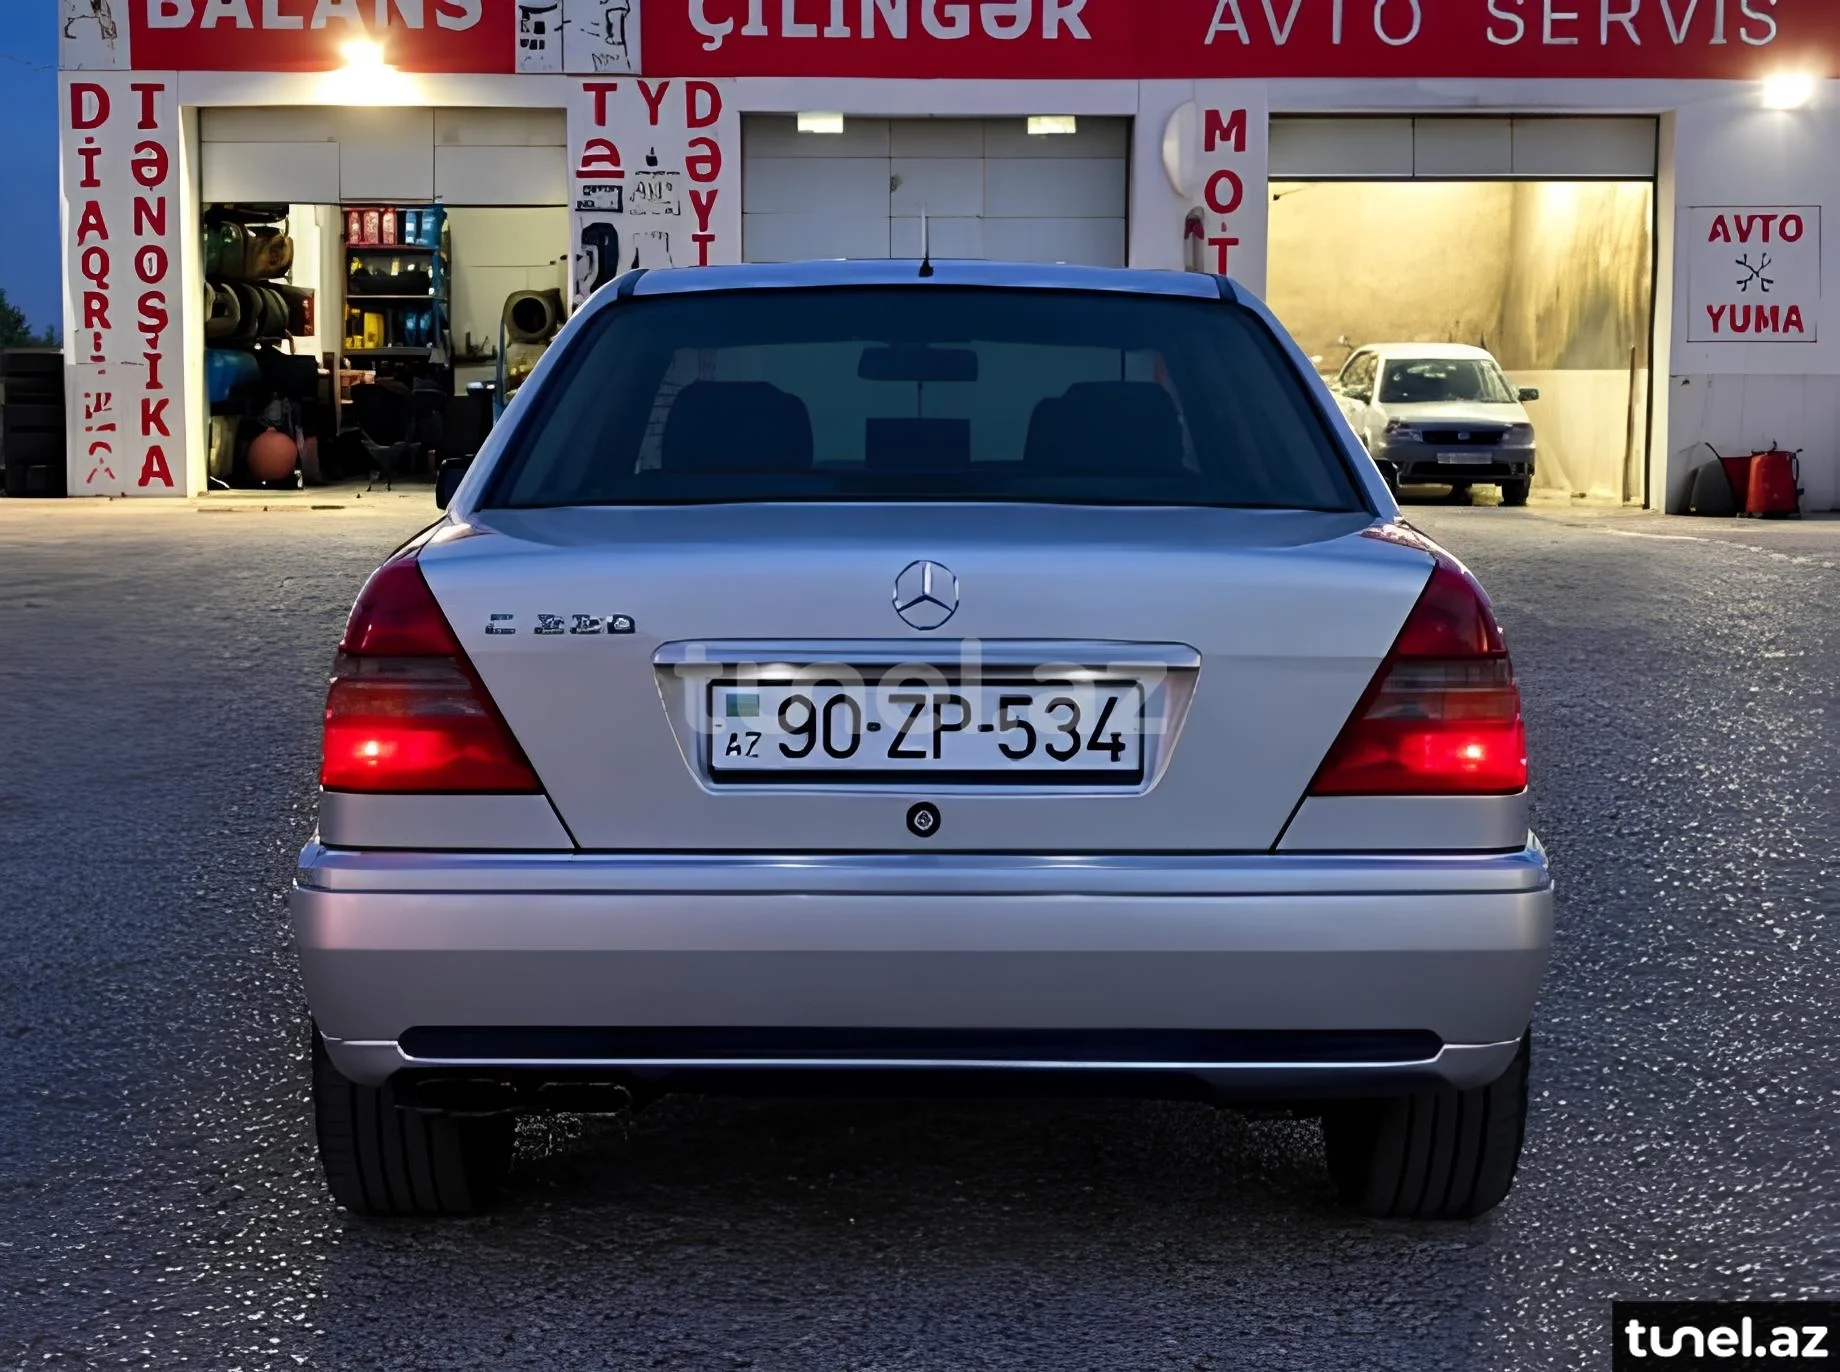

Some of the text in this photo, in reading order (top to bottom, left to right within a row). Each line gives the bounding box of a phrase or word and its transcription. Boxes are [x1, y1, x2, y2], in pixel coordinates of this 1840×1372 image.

[147, 0, 483, 30] BALANS
[1708, 214, 1804, 243] AVTO
[1706, 304, 1804, 333] YUMA
